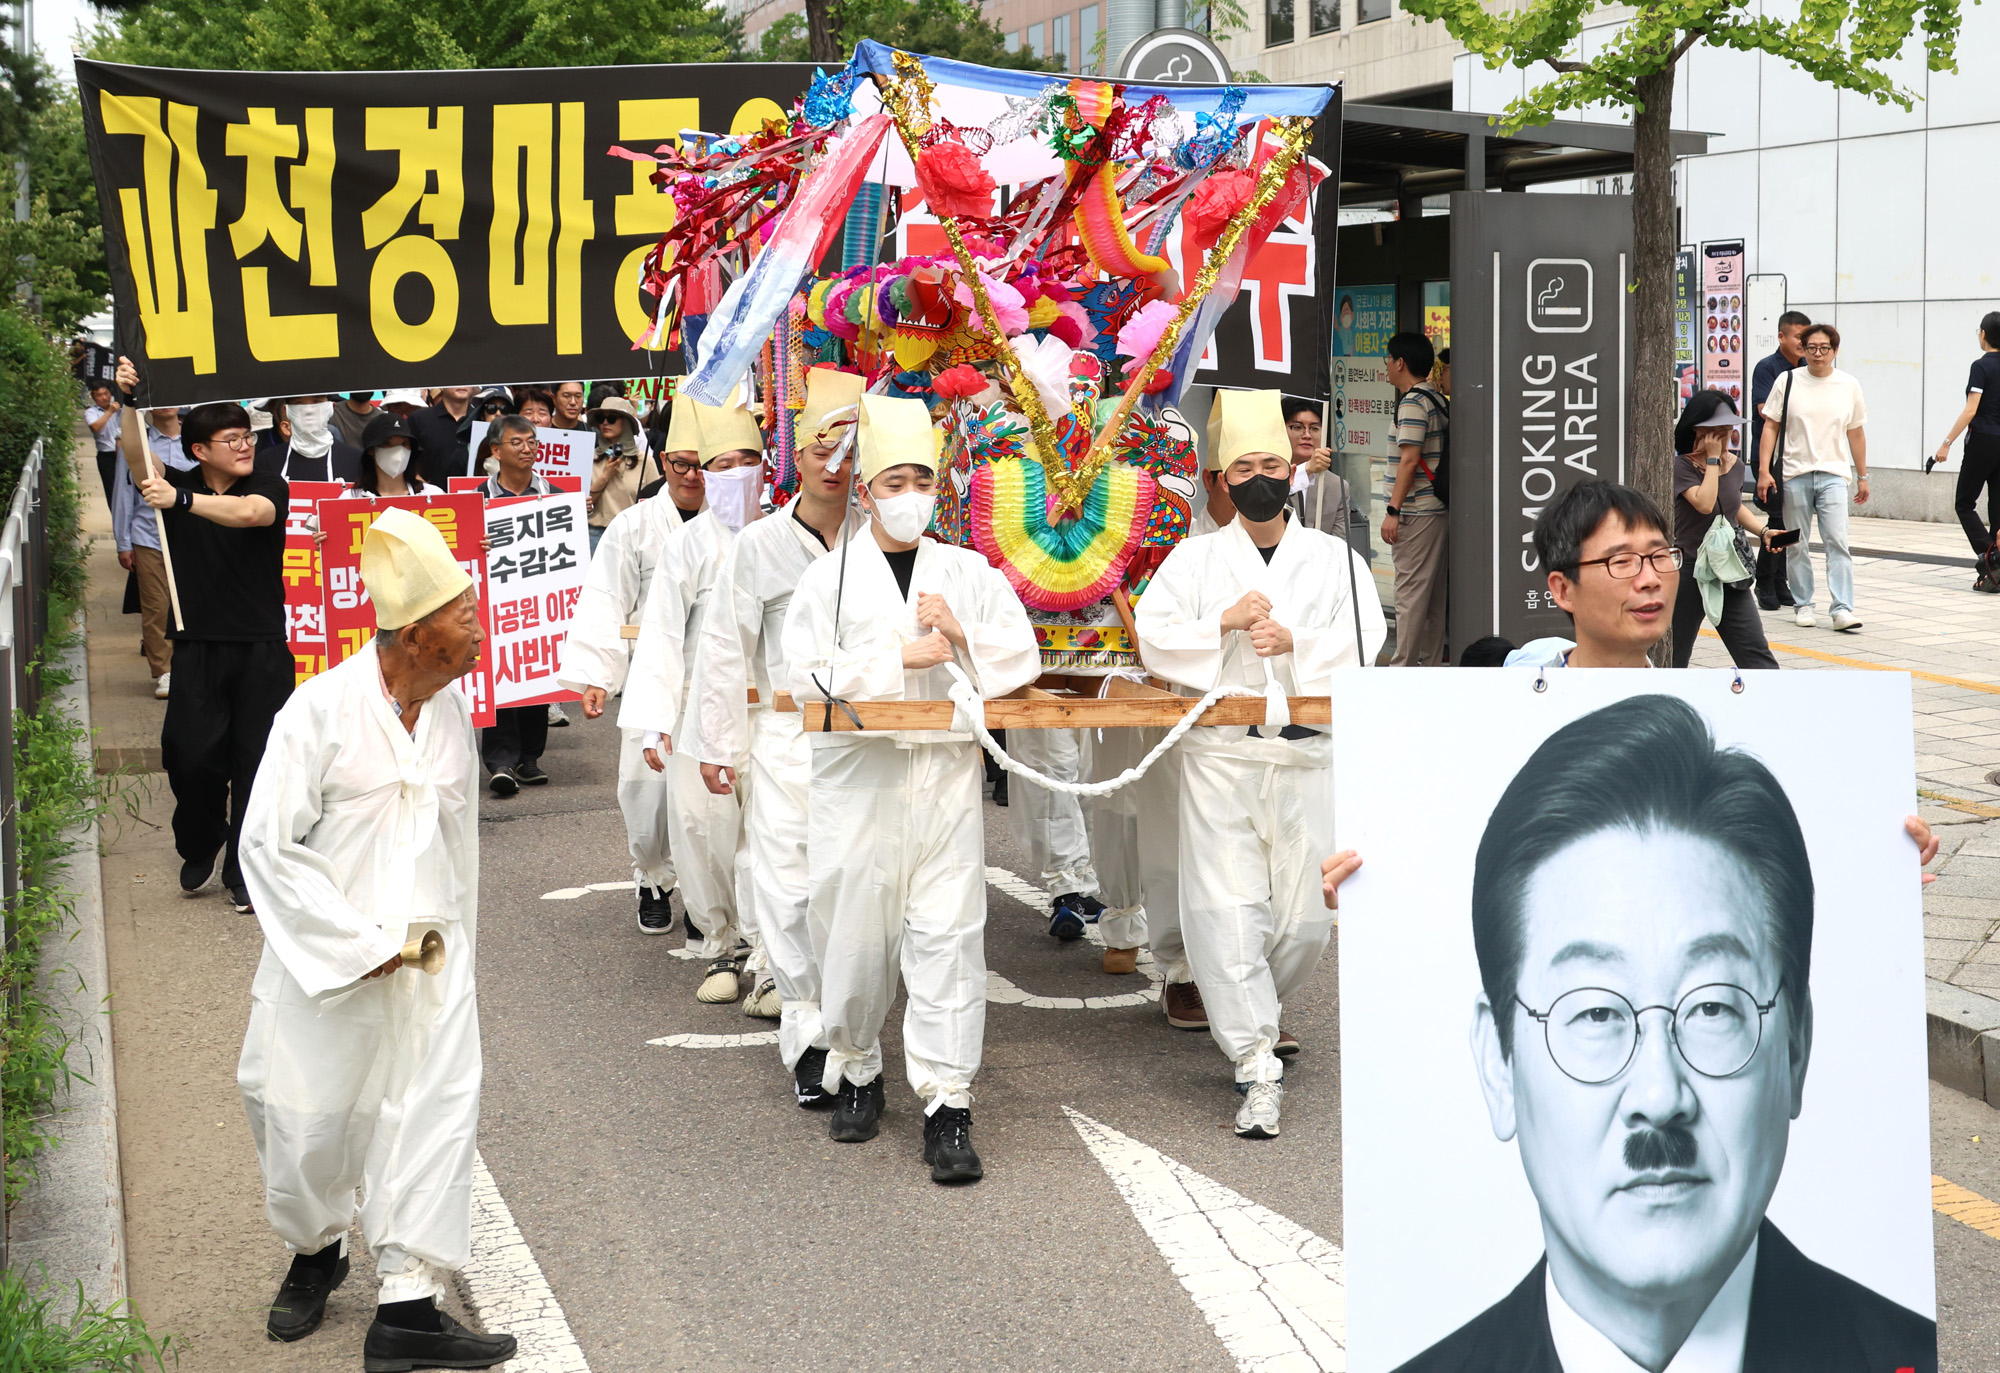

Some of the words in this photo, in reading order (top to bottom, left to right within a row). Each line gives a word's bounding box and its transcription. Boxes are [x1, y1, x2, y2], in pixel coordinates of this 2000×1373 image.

[100, 88, 812, 375] 과천경마공
[1355, 311, 1377, 330] 사회적
[1355, 332, 1380, 354] 이용자
[1564, 353, 1598, 476] AREA
[1348, 430, 1371, 445] 대화금지
